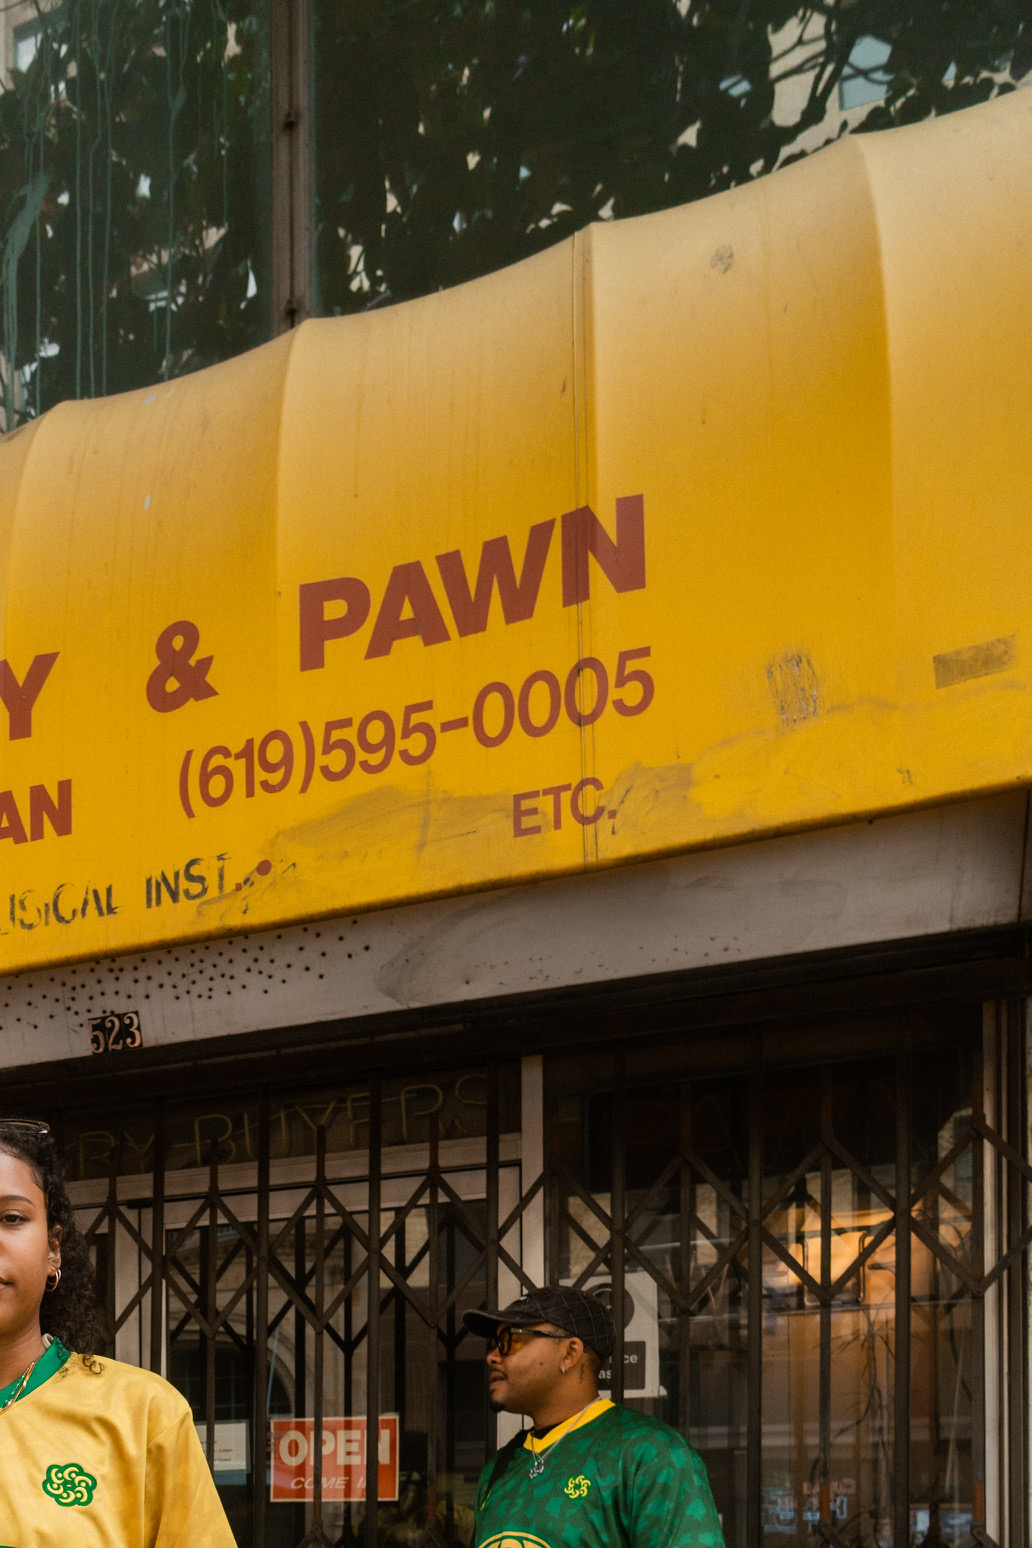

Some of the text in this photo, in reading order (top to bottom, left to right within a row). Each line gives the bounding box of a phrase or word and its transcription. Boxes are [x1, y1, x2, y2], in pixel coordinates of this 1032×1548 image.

[146, 620, 219, 714] &
[298, 494, 646, 672] PAWN
[179, 646, 655, 819] (619)595-0005
[512, 777, 618, 838] ETC.
[90, 1013, 142, 1053] 523
[279, 1429, 390, 1466] OPEN
